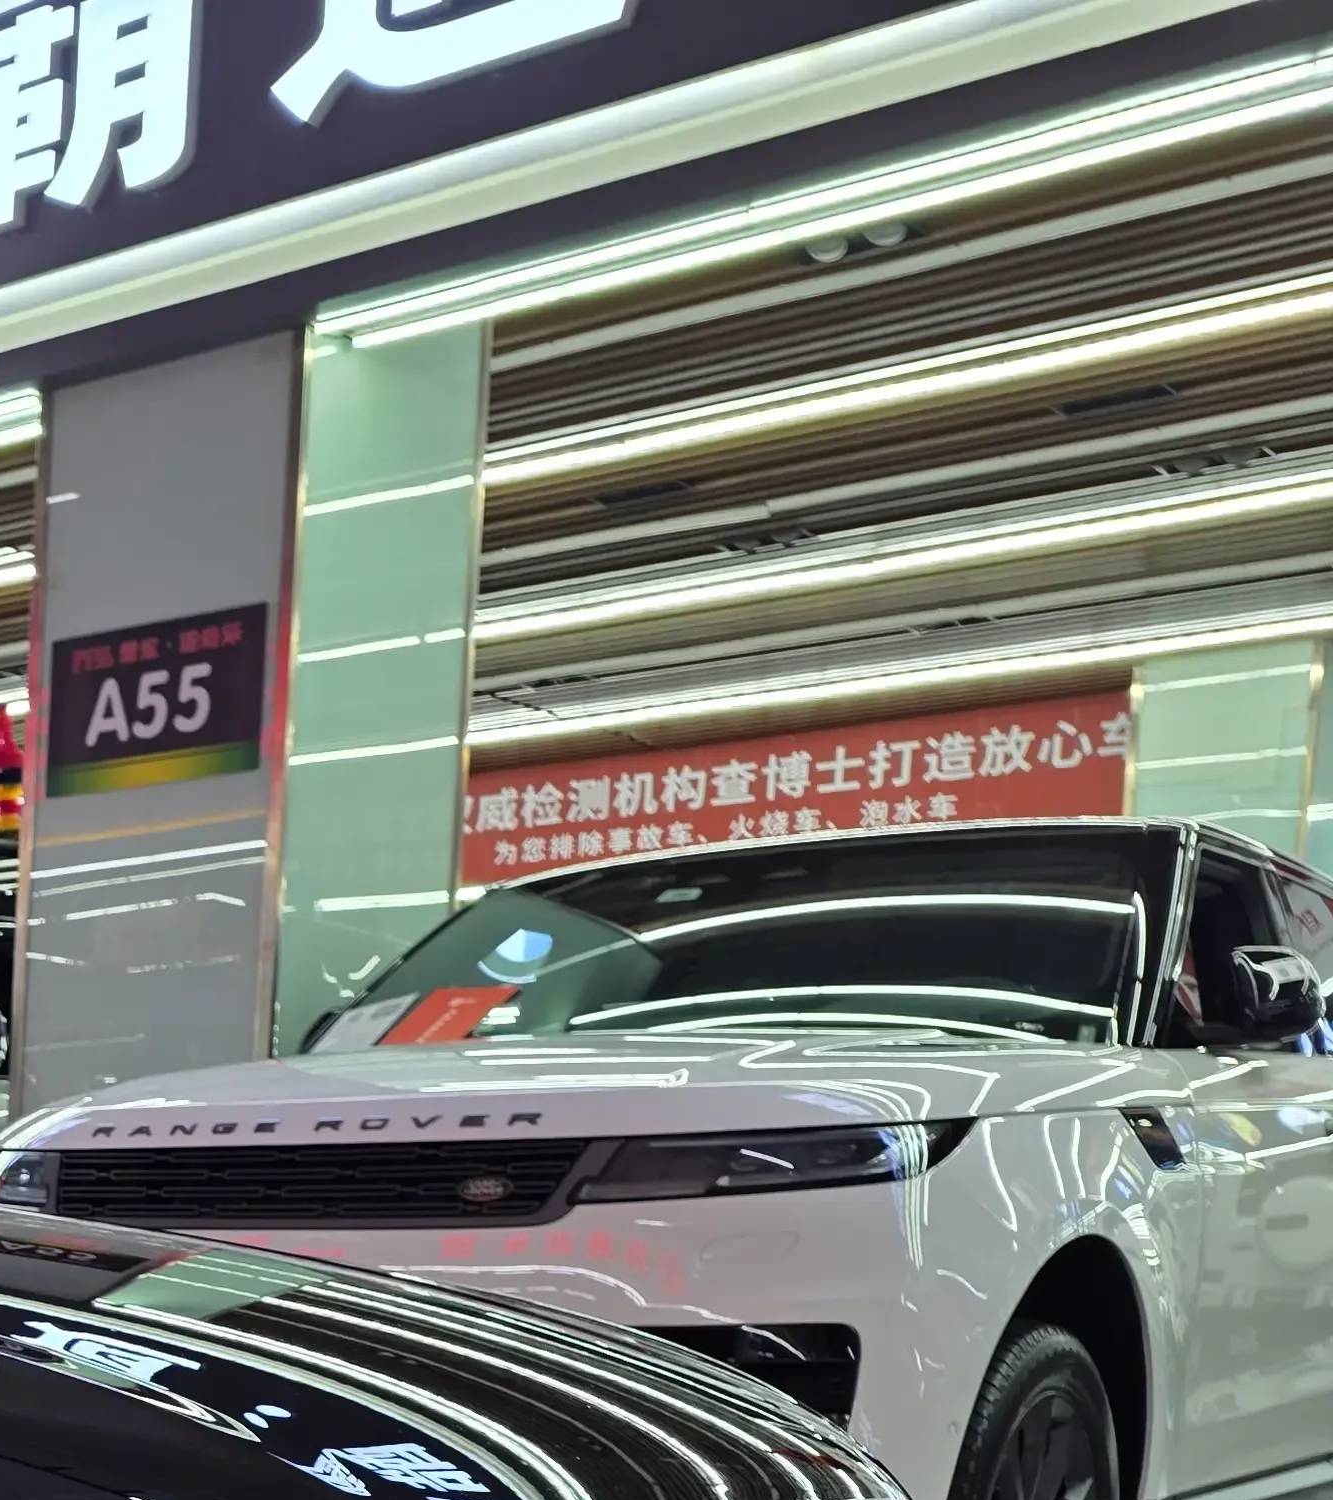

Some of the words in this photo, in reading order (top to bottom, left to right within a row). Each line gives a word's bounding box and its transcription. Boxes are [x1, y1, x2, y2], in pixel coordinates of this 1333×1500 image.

[85, 662, 213, 748] A55
[91, 1120, 281, 1138] RANGE
[313, 1112, 543, 1132] ROVER
